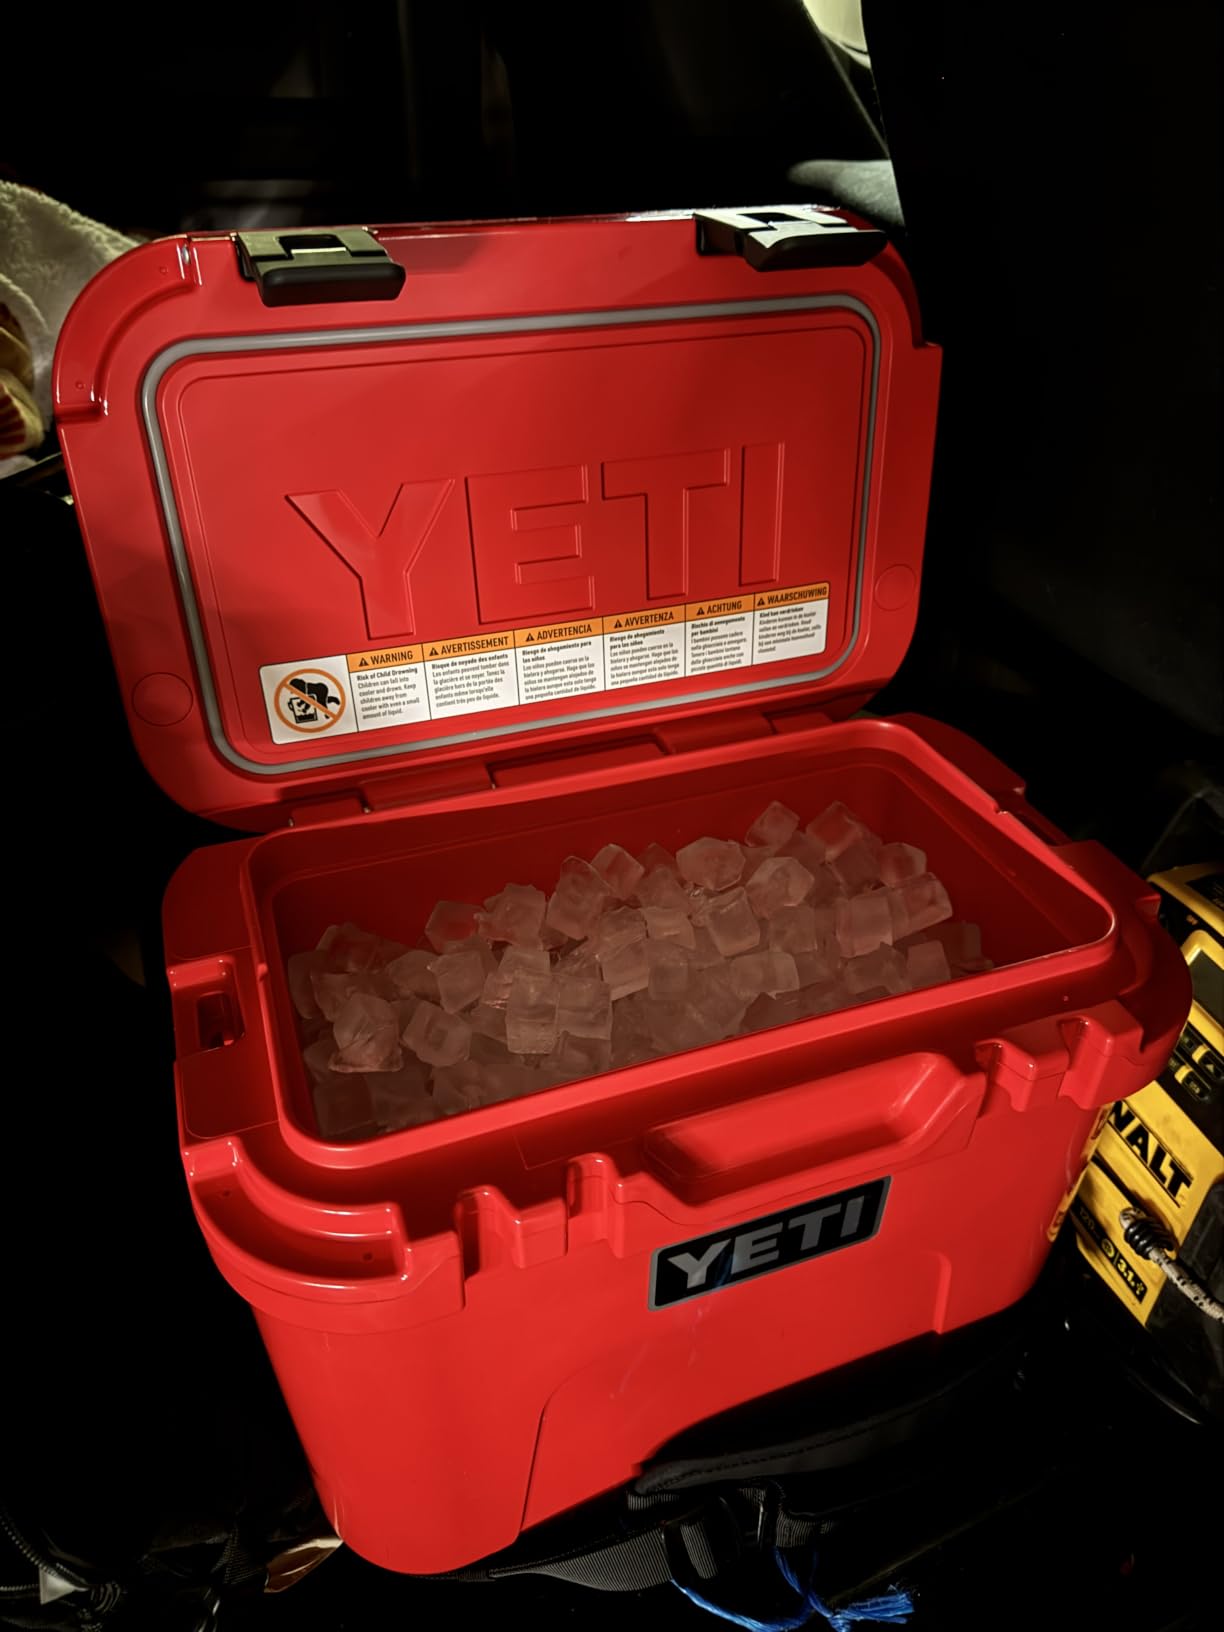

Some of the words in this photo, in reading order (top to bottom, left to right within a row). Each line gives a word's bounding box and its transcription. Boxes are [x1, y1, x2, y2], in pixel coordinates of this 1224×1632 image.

[285, 442, 785, 641] YETI
[768, 586, 828, 605] WAARSCHUWING
[707, 600, 742, 615] ACHTUNG
[625, 611, 674, 628] AVVERTENZA
[537, 624, 592, 640] ADVERTENCIA
[441, 636, 509, 655] AVERTISSEMENT
[370, 650, 414, 665] WARNING
[667, 1195, 865, 1289] YETI
